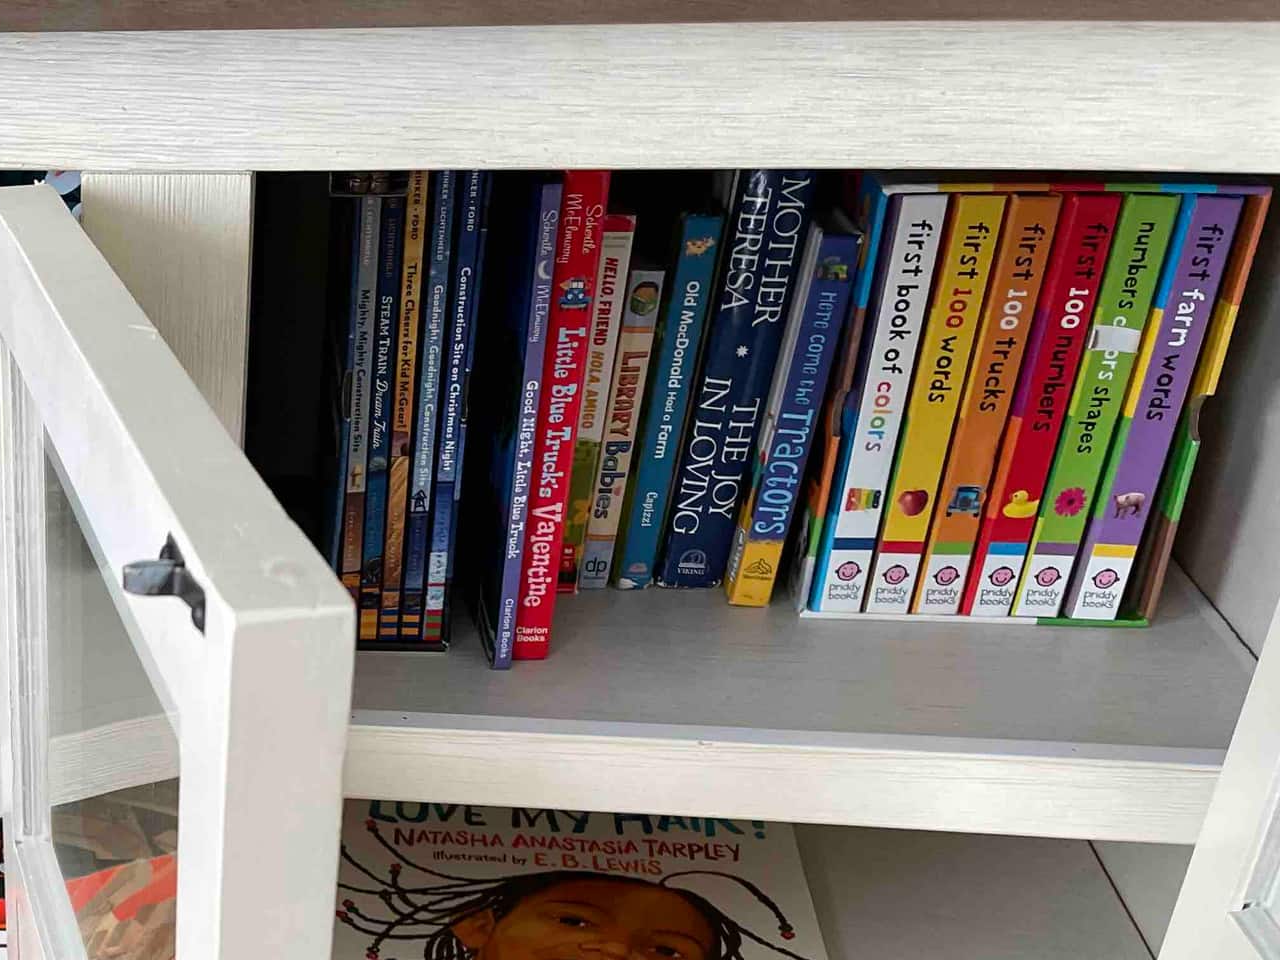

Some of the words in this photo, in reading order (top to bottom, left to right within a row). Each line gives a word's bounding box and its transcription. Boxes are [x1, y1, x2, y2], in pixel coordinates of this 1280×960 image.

[410, 214, 419, 241] FORD
[466, 207, 476, 231] FORD
[541, 209, 559, 256] Schertle
[556, 193, 584, 264] McElmurry
[582, 203, 605, 254] Schertle
[721, 187, 773, 313] TERESA
[751, 175, 811, 328] MOTHER
[902, 219, 933, 278] first
[956, 222, 991, 281] first
[1012, 222, 1046, 283] first
[1075, 222, 1109, 280] first
[1118, 221, 1156, 311] numbers
[1188, 223, 1224, 282] first
[406, 263, 418, 297] Three
[596, 257, 619, 301] HELLO,
[683, 280, 700, 307] Old
[358, 290, 370, 328] Mighty,
[379, 296, 393, 337] STEAM
[403, 300, 416, 338] Cheers
[429, 284, 445, 344] Goodnight,
[455, 267, 471, 342] Construction
[592, 301, 613, 346] FRIEND
[817, 290, 837, 333] Here
[888, 284, 919, 342] book
[944, 287, 972, 330] 100
[998, 288, 1029, 332] 100
[1059, 287, 1089, 330] 100
[1167, 288, 1206, 347] farm
[356, 330, 369, 368] Mighty
[400, 360, 412, 378] Kid
[401, 341, 413, 358] for
[452, 344, 465, 366] Site
[554, 327, 588, 379] Little
[669, 309, 695, 389] MacDonald
[807, 333, 827, 376] come
[882, 346, 903, 375] of
[926, 334, 959, 405] words
[423, 346, 439, 404] Goodnight,
[450, 367, 459, 382] on
[608, 351, 649, 437] LIBRARY
[698, 374, 733, 413] IN
[798, 375, 811, 405] the
[979, 335, 1017, 412] trucks
[1032, 335, 1074, 433] numbers
[1146, 353, 1181, 421] words
[352, 369, 368, 432] Construction
[372, 377, 389, 418] Dream
[443, 382, 461, 441] Christmas
[523, 380, 539, 413] Good
[548, 383, 578, 424] Blue
[581, 387, 601, 430] AMIGO
[665, 391, 677, 413] Had
[863, 380, 893, 453] colors
[371, 421, 388, 449] Train
[419, 404, 435, 466] Construction
[517, 416, 536, 458] Night,
[721, 398, 761, 463] THE
[1077, 385, 1111, 454] shapes
[352, 434, 363, 453] Site
[442, 441, 456, 471] Night
[653, 422, 673, 460] Farm
[515, 460, 532, 492] Little
[538, 427, 573, 498] Truck's
[593, 440, 633, 520] Babies
[673, 420, 722, 536] LOVING
[754, 406, 814, 543] Tractors
[513, 493, 528, 521] Blue
[709, 470, 742, 519] JOY
[507, 522, 524, 559] Truck
[523, 501, 564, 608] Valentine
[585, 557, 608, 576] dp
[677, 567, 705, 575] VIKING
[828, 584, 862, 594] priddy
[828, 592, 858, 601] books
[874, 594, 906, 604] books
[875, 586, 909, 597] priddy
[925, 596, 956, 605] books
[926, 588, 959, 598] priddy
[979, 597, 1011, 606] books
[981, 588, 1015, 599] priddy
[1025, 597, 1057, 607] books
[1026, 588, 1060, 599] priddy
[1082, 599, 1113, 609] books
[1083, 590, 1118, 601] priddy
[502, 597, 514, 631] Clarion
[516, 626, 548, 635] Clarion
[499, 632, 512, 659] Books
[516, 635, 546, 643] Books
[394, 828, 505, 849] NATASHA
[641, 838, 741, 862] TARPLEY
[432, 851, 508, 864] illustrated
[511, 854, 528, 866] by
[534, 853, 557, 867] E.
[562, 854, 588, 870] B.
